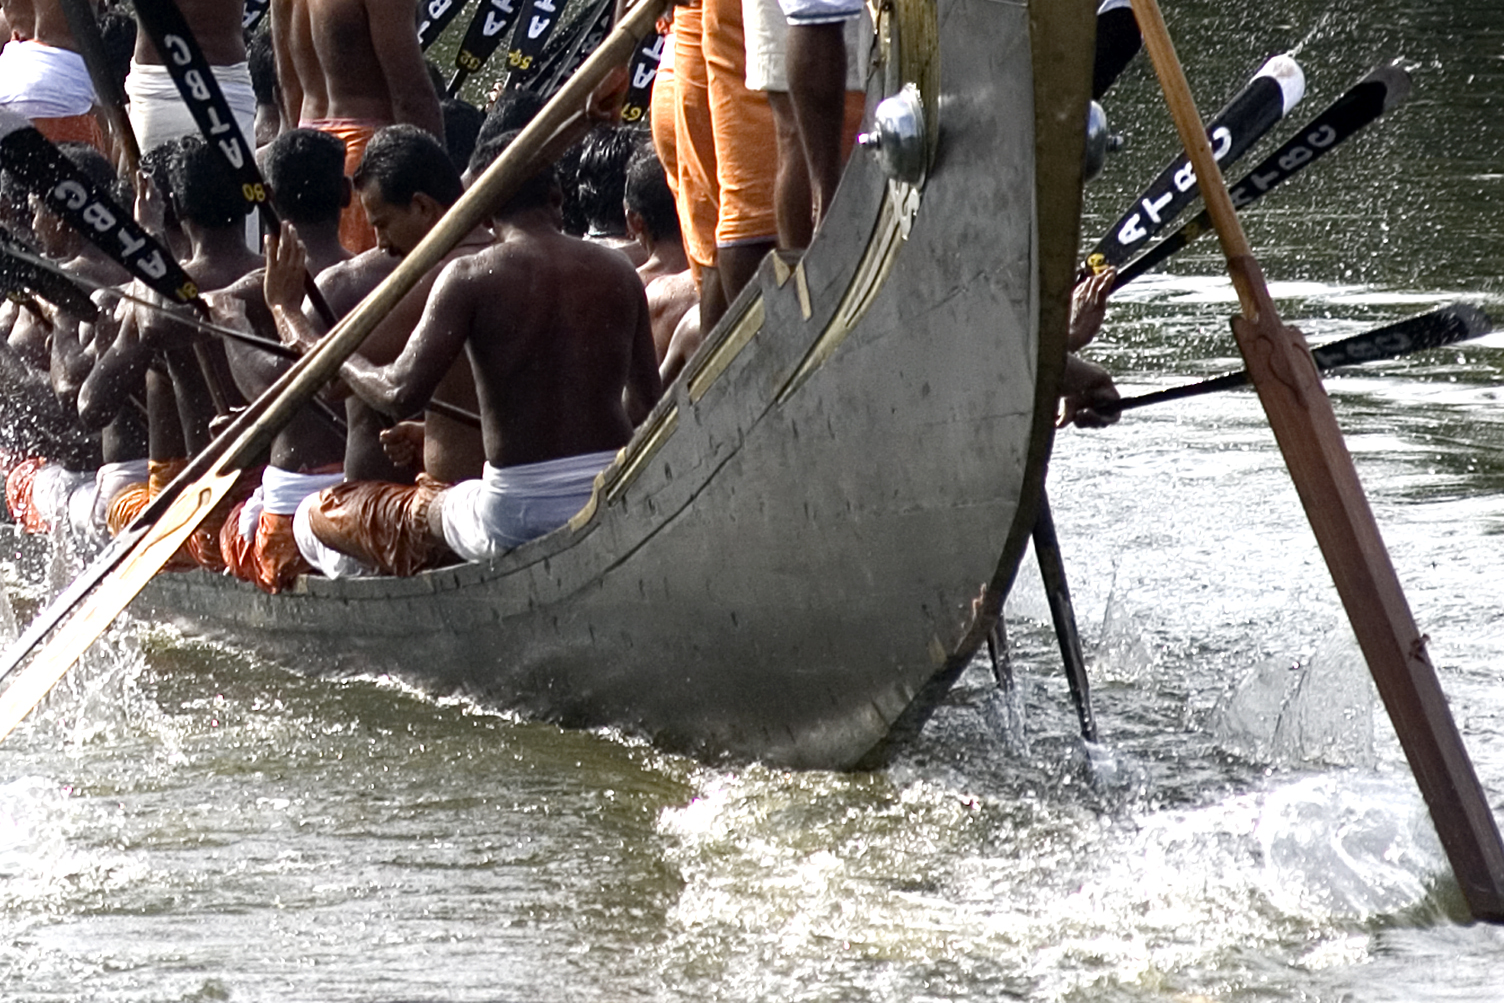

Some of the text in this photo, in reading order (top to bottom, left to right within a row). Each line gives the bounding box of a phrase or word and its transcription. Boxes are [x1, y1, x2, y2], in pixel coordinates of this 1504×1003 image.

[164, 34, 245, 170] ATBC
[241, 182, 267, 204] 80
[53, 179, 167, 280] ATBC
[1315, 330, 1412, 368] TBC
